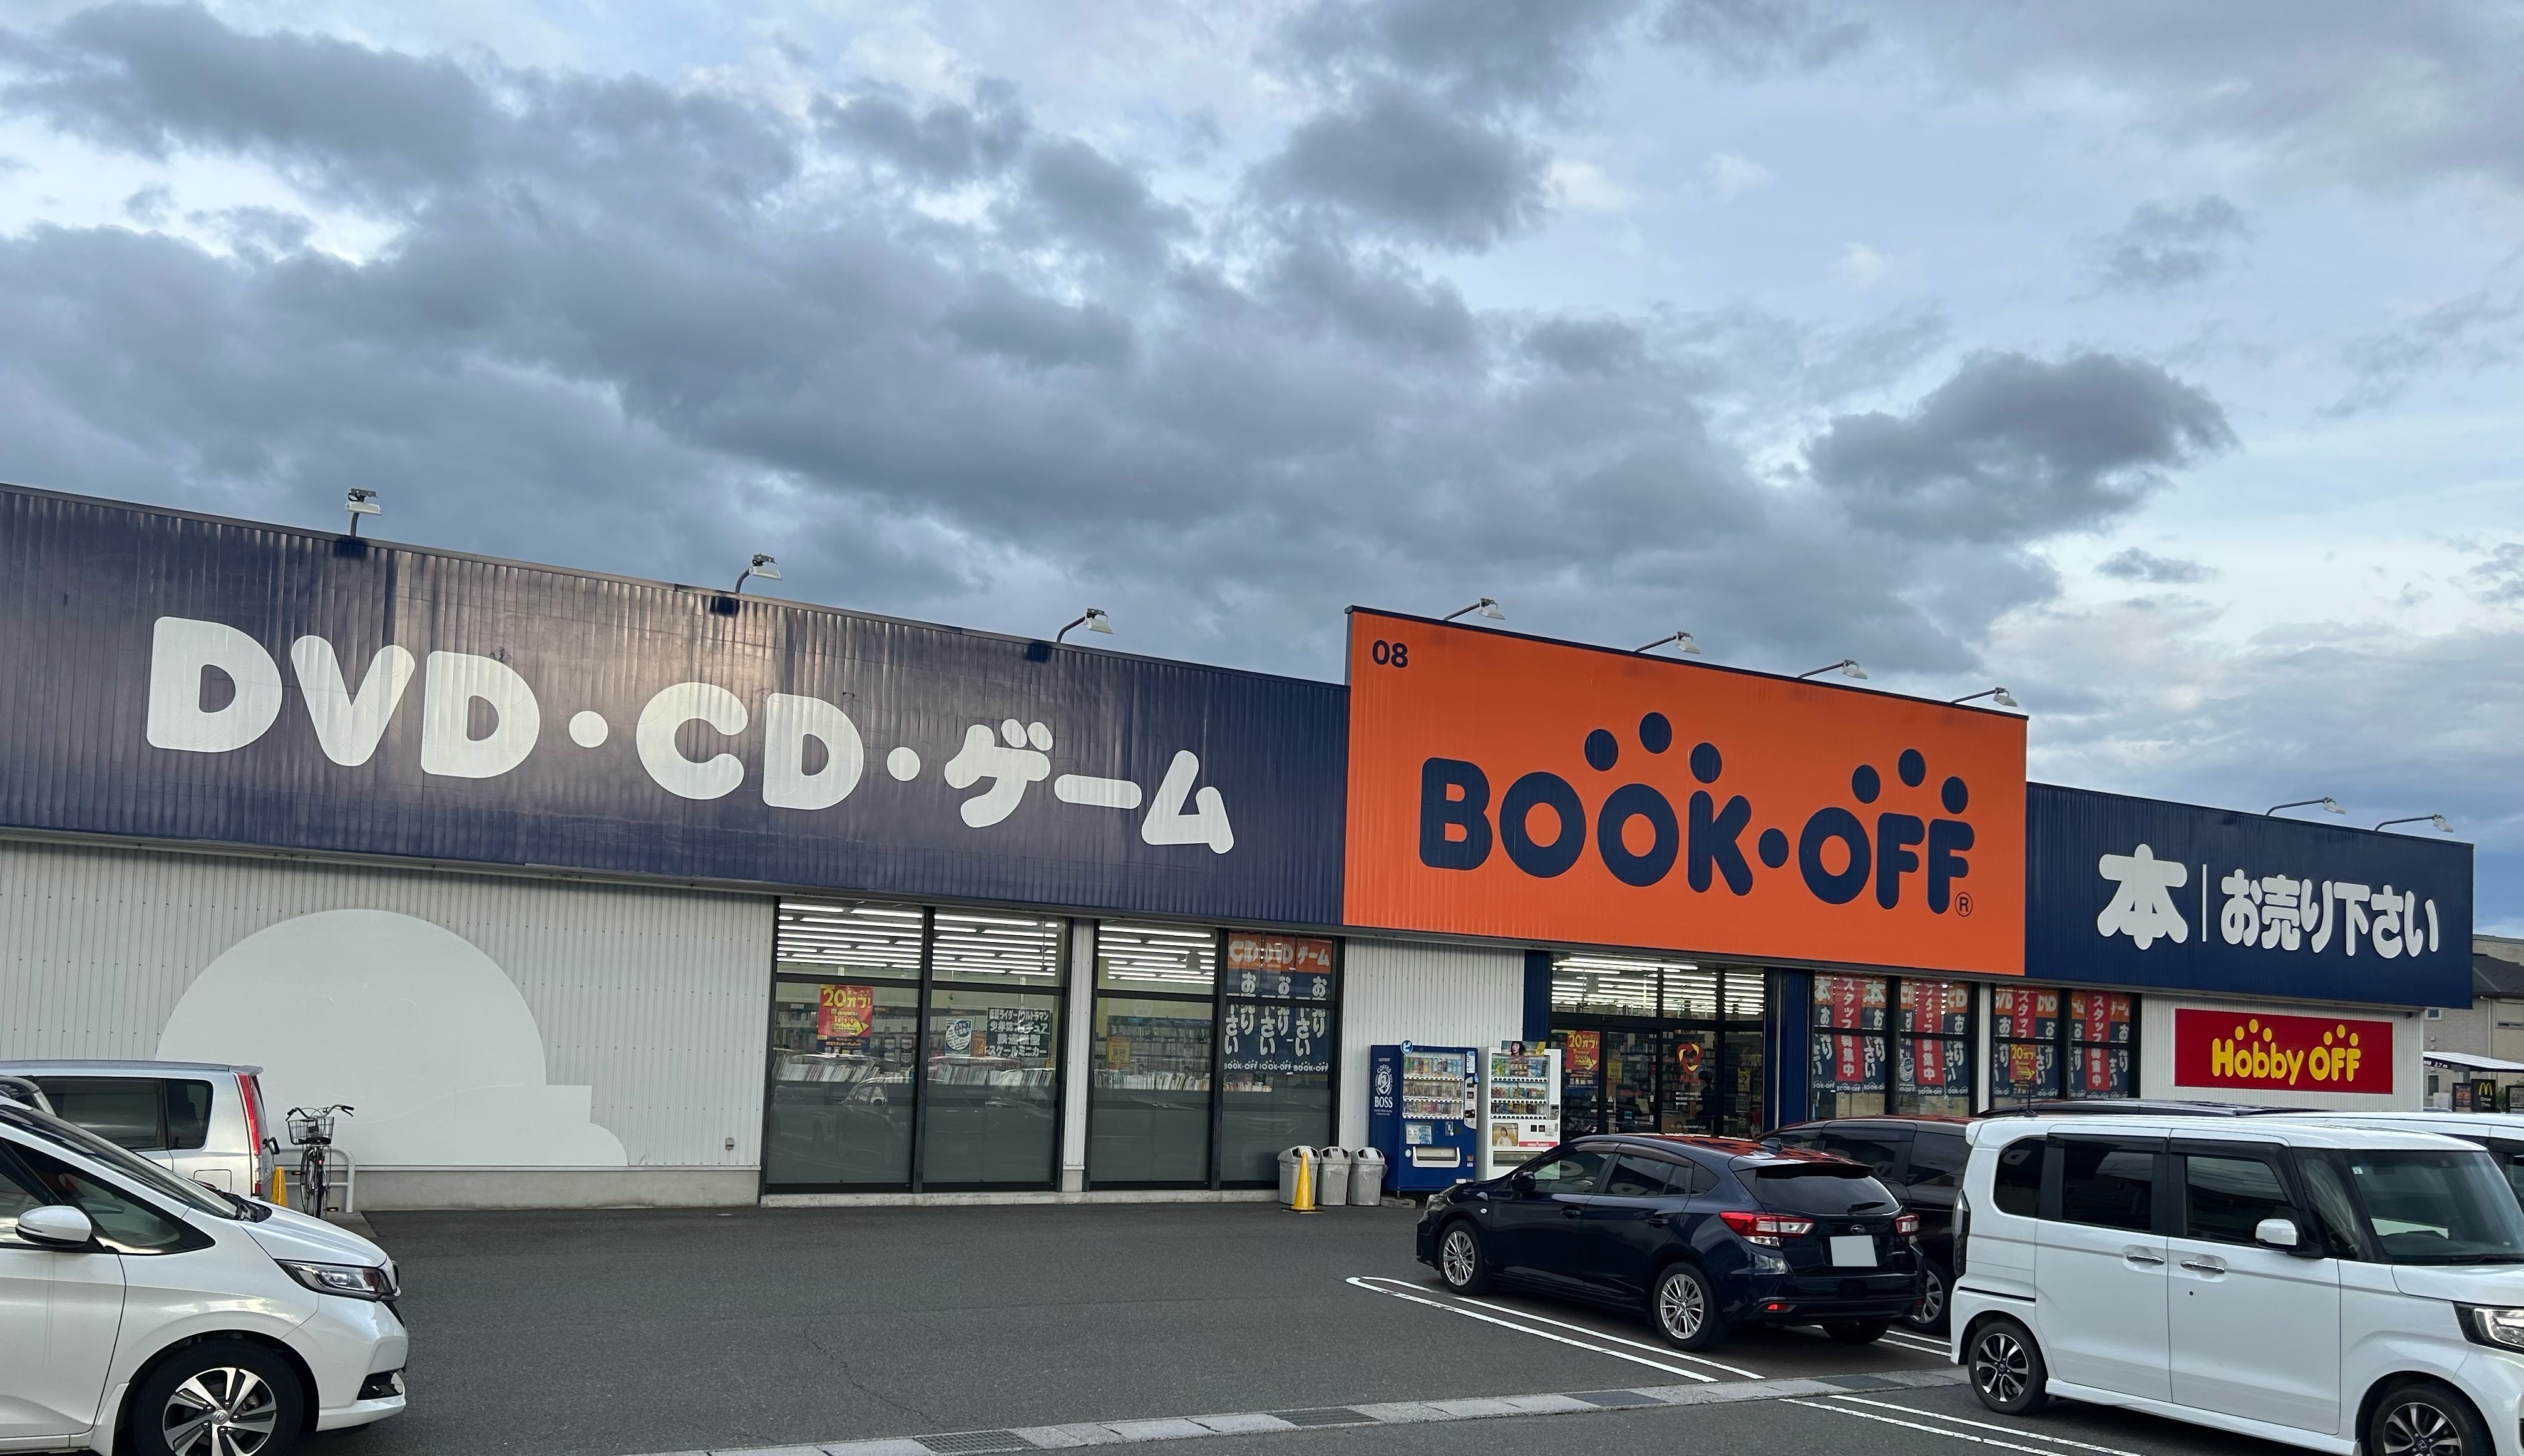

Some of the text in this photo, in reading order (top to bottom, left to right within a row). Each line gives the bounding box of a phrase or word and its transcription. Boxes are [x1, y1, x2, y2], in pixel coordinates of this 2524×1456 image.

[1372, 640, 1408, 669] 08
[2097, 843, 2439, 959] 本 お売り下さい
[1229, 940, 1259, 963] CD
[1297, 945, 1330, 967] ゲーム
[1814, 977, 1832, 1002] 本
[1862, 980, 1886, 1005] 本
[2212, 1037, 2361, 1086] Hobby OFF
[1374, 1096, 1393, 1109] BOSS
